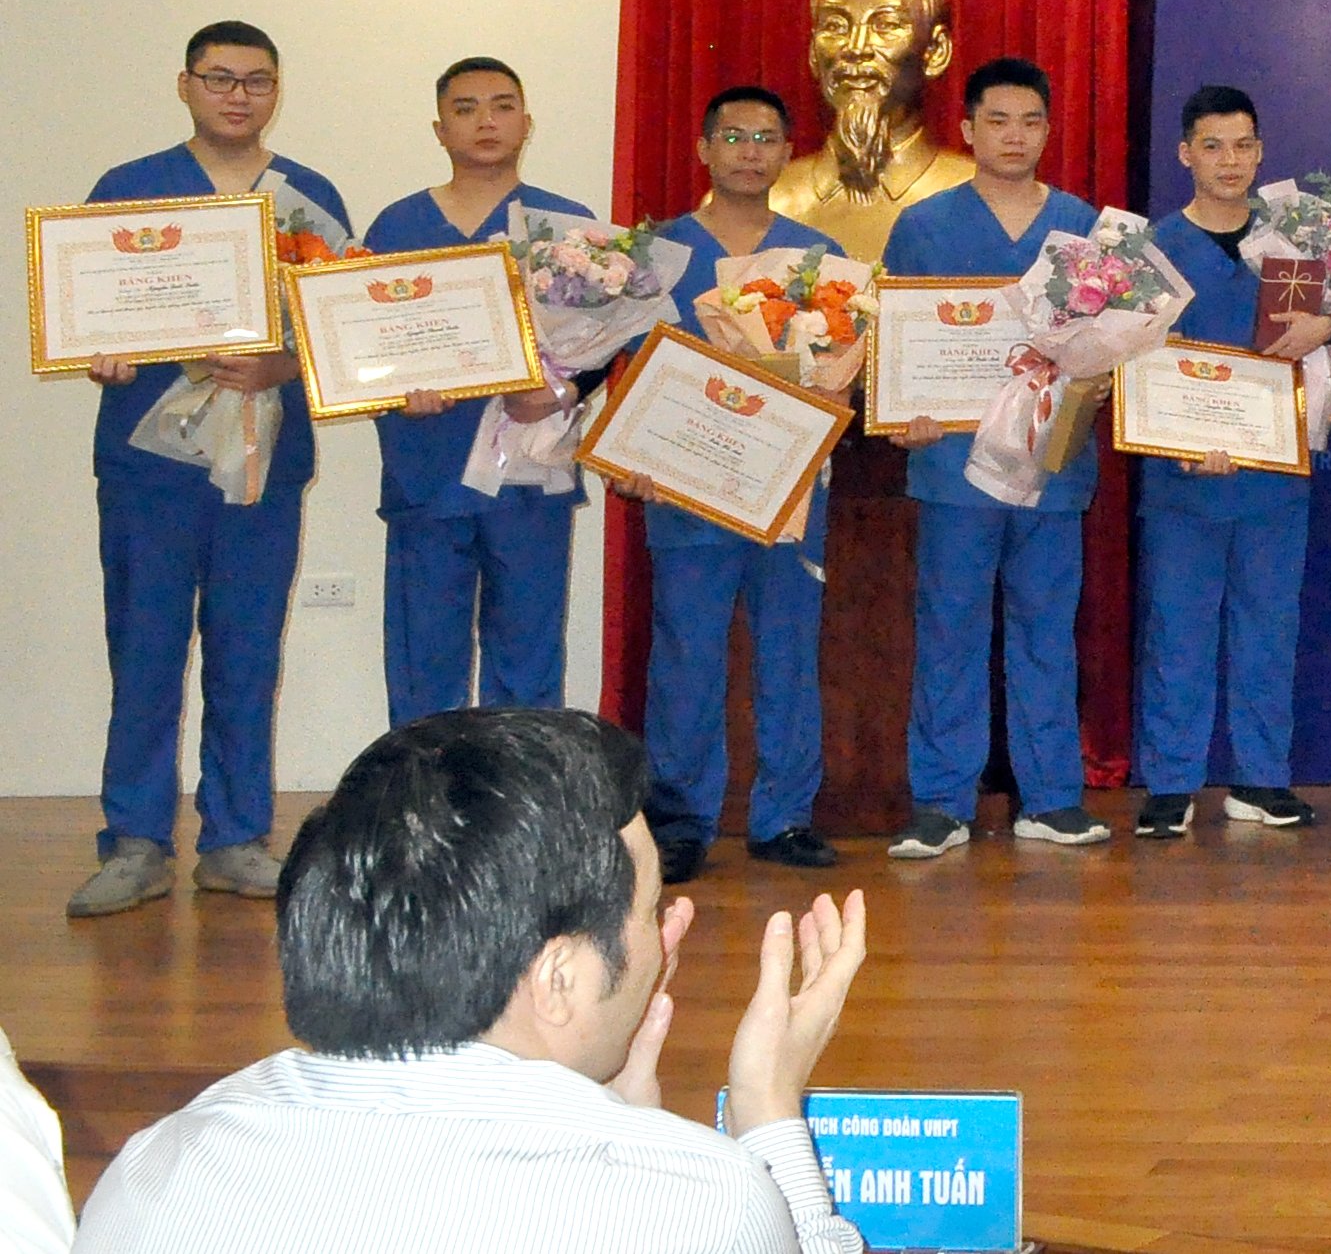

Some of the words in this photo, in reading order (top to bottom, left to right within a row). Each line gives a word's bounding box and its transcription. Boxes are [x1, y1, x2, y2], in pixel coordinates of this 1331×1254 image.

[841, 1114, 880, 1137] CÔNG
[882, 1114, 921, 1137] ĐOÀN
[923, 1118, 960, 1138] VNPT
[860, 1168, 912, 1204] ANH
[919, 1157, 986, 1205] TUẤN
